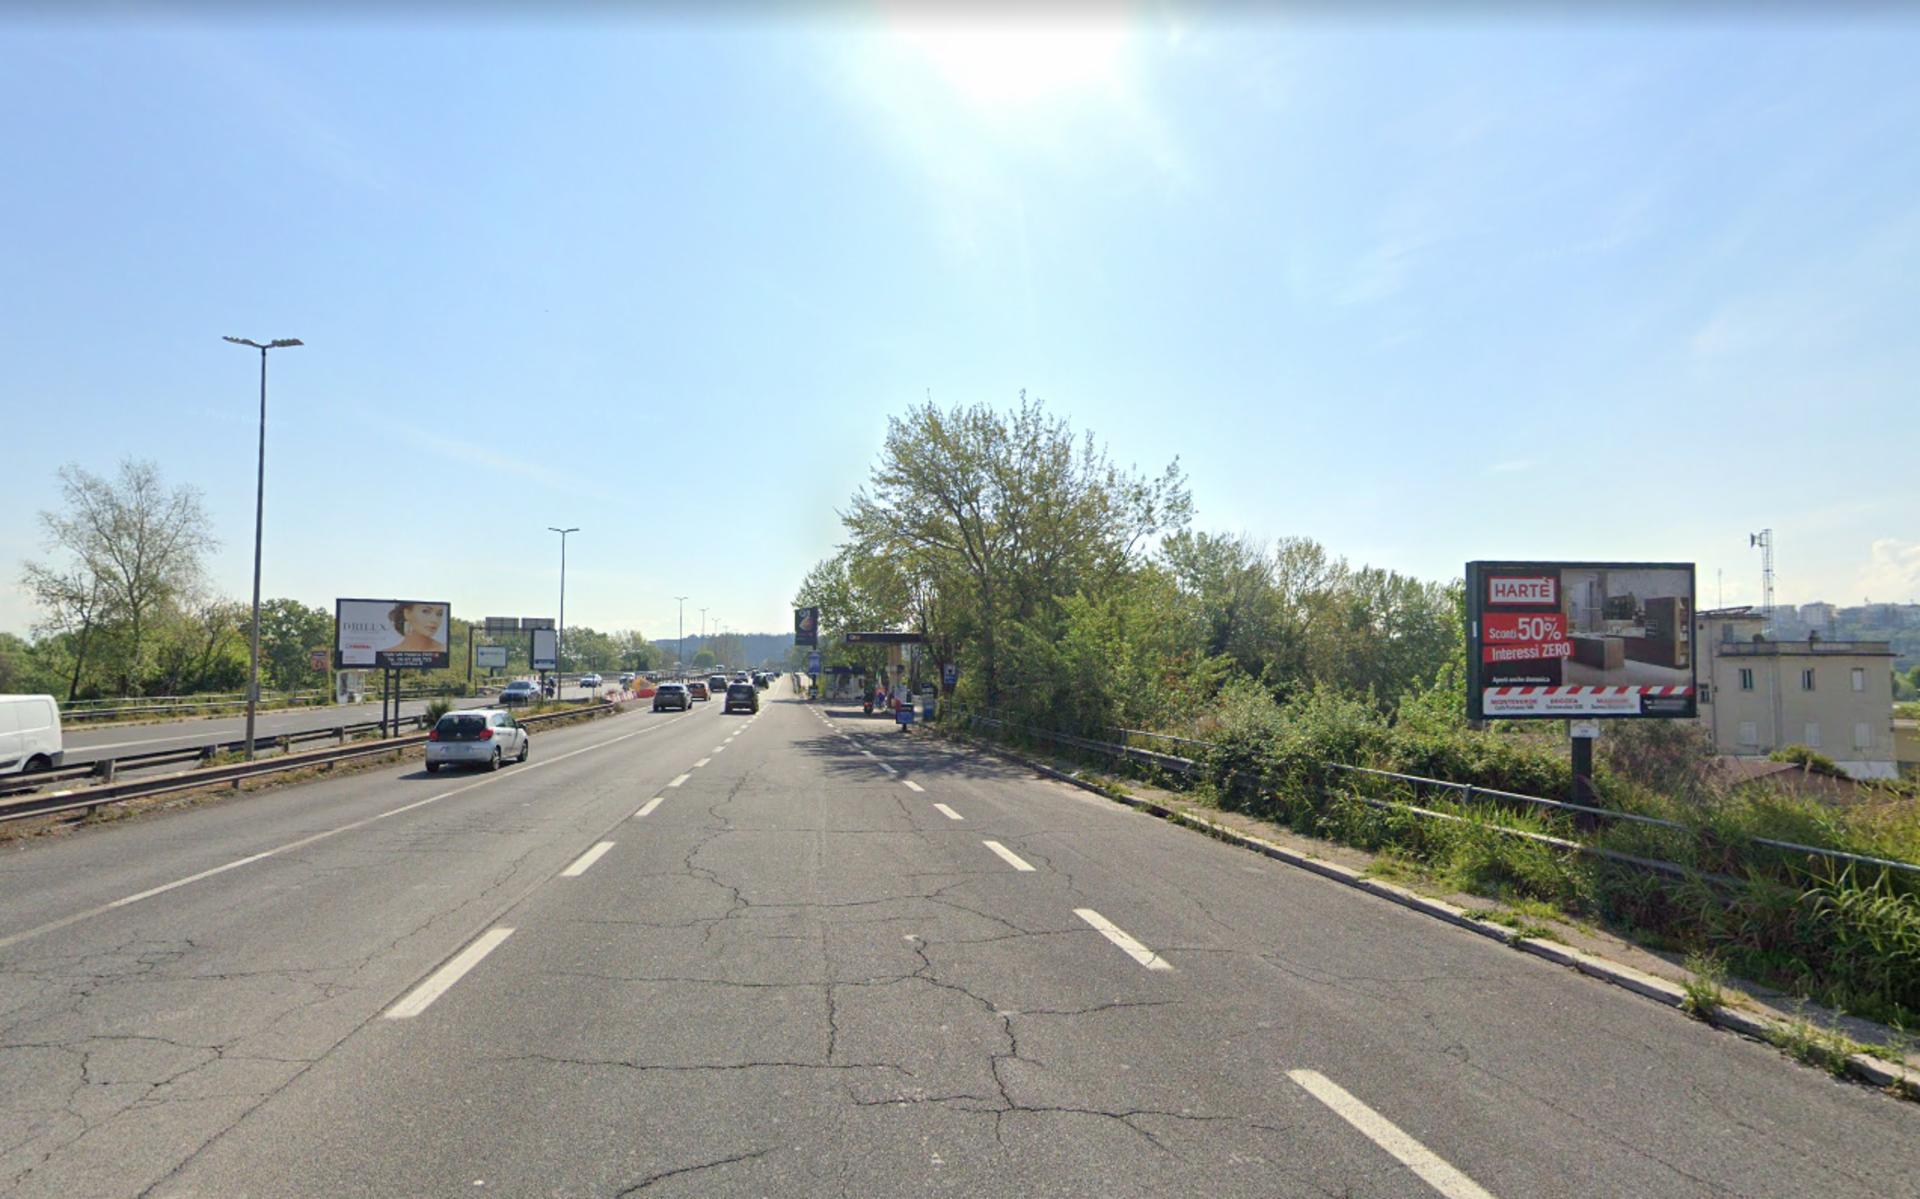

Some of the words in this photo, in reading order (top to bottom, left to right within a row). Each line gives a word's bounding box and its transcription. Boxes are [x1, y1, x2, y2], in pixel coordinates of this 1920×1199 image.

[1495, 577, 1551, 598] HARTÈ
[1489, 627, 1517, 640] Sconti
[1518, 617, 1562, 640] 50%
[1492, 644, 1540, 661] Interessi
[1542, 642, 1571, 657] ZERO
